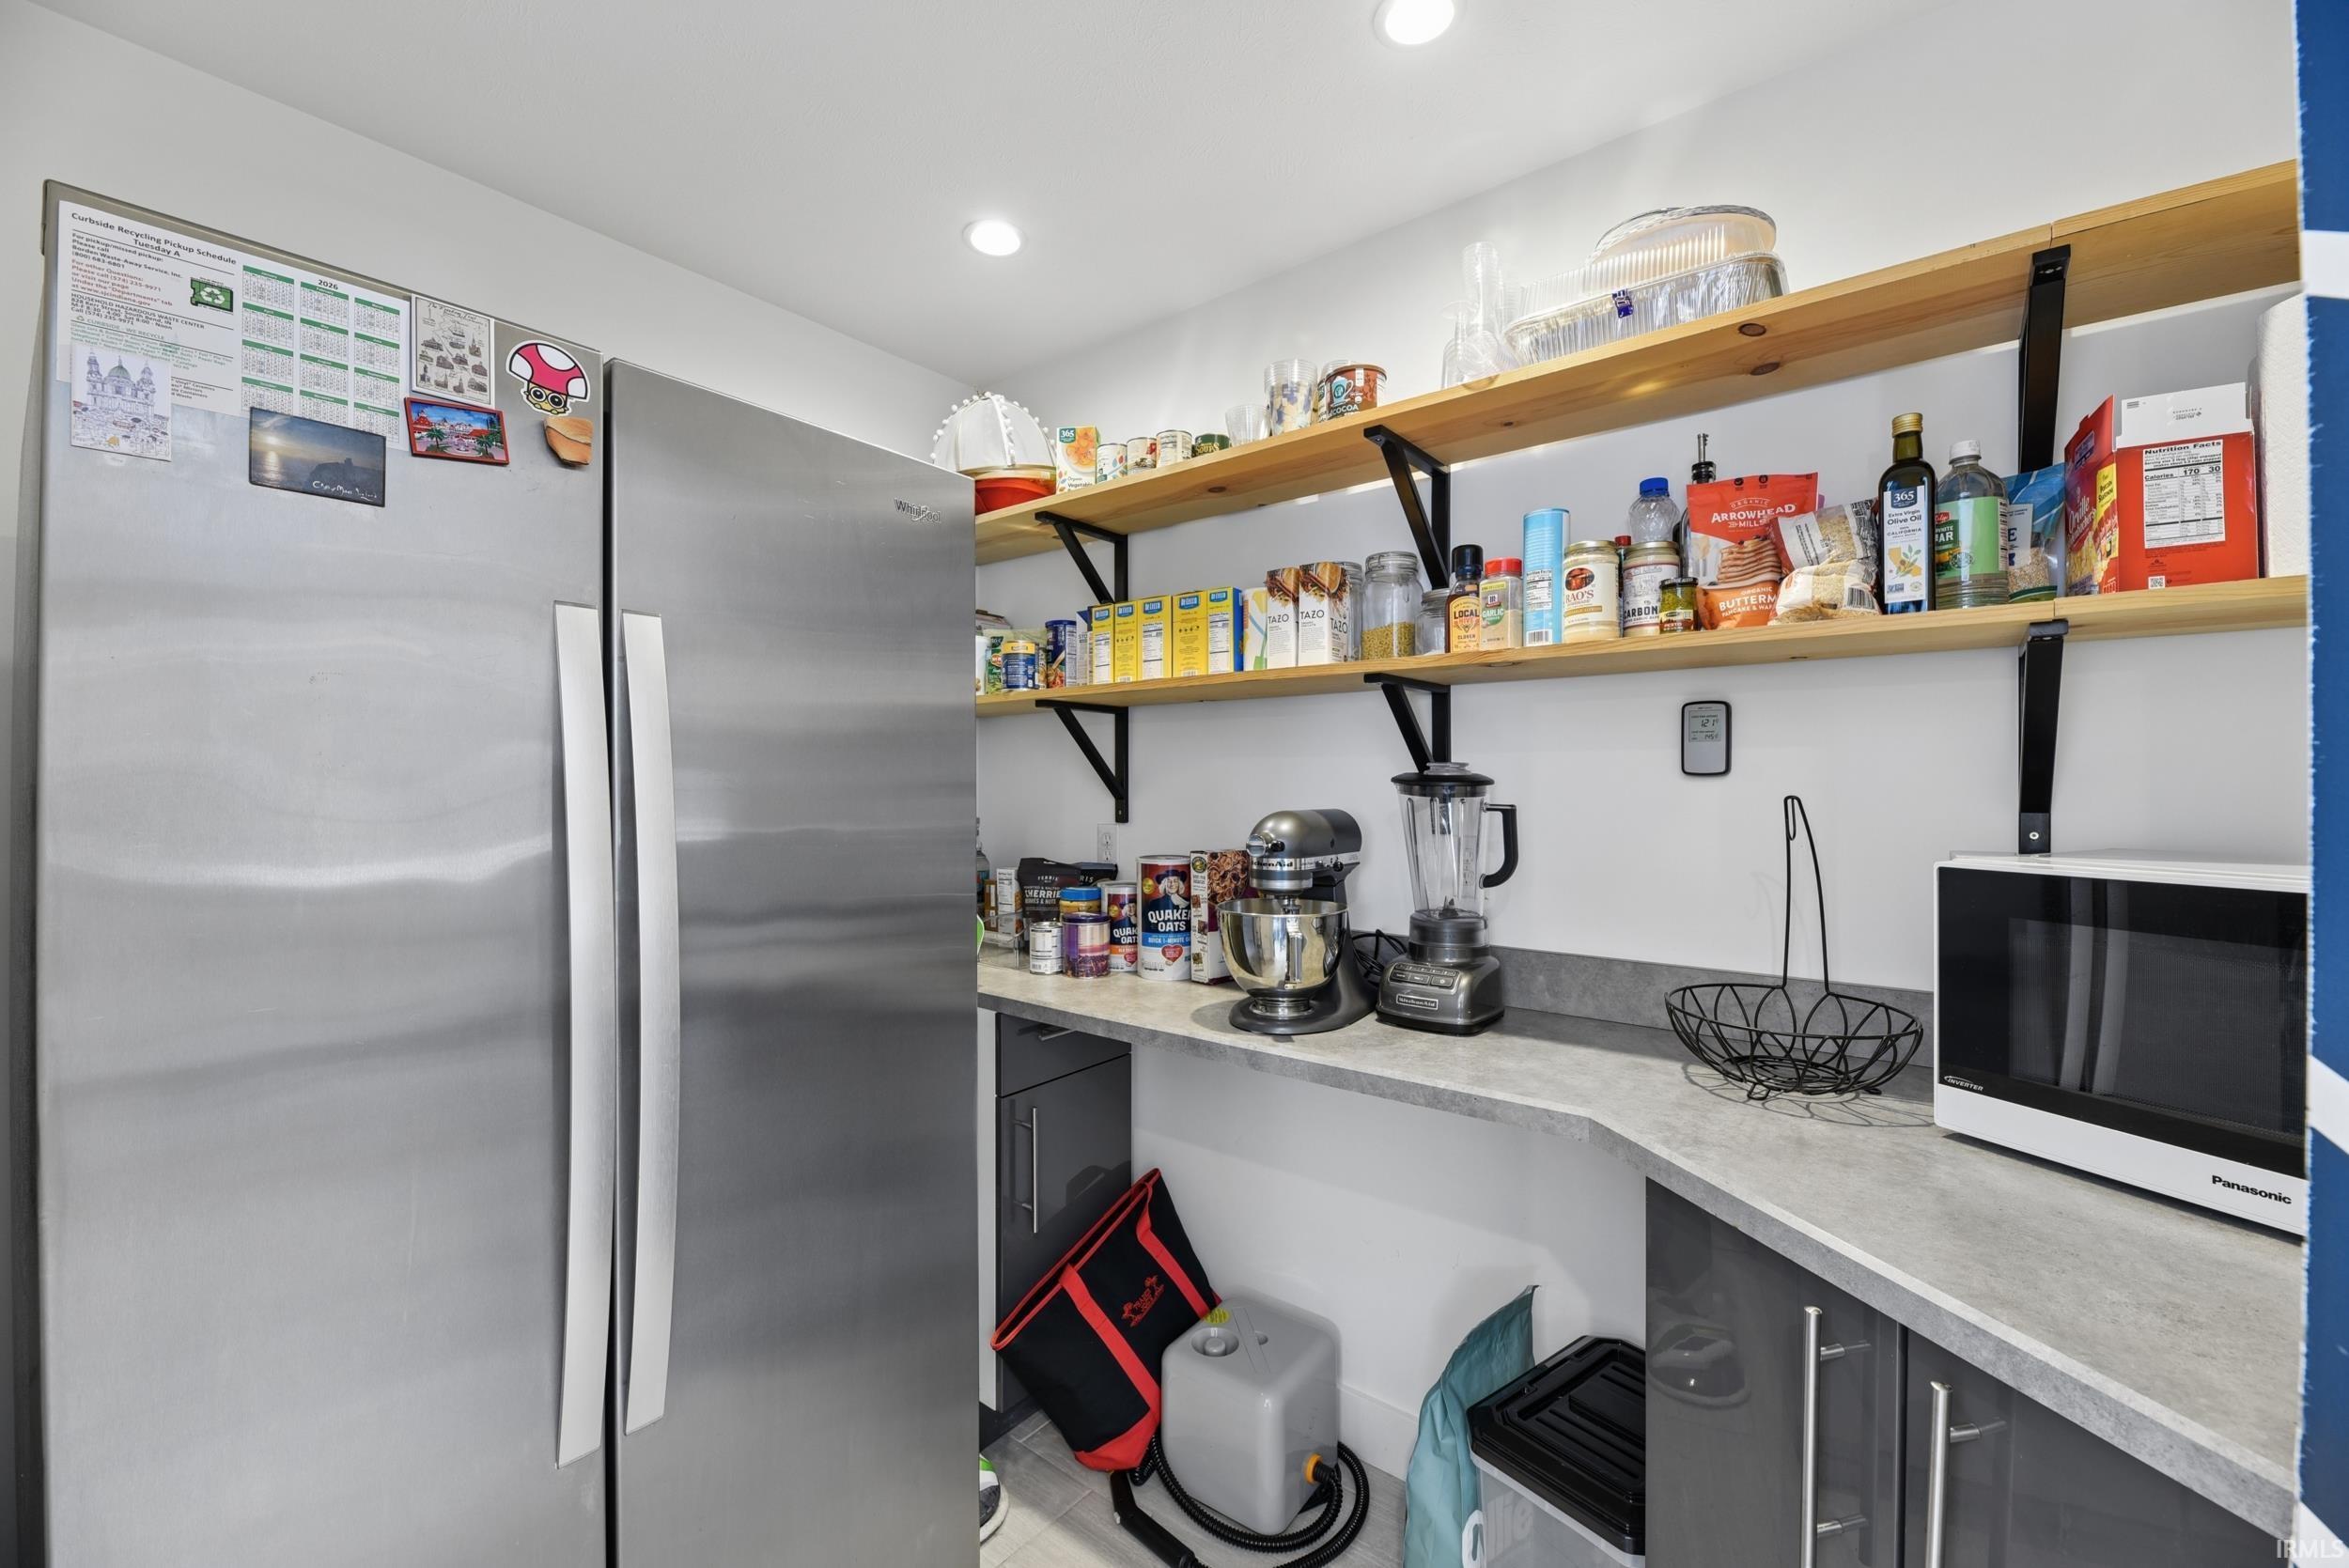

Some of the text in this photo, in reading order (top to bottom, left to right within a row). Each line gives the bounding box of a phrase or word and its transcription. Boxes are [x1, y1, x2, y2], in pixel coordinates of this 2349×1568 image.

[71, 212, 237, 264] Curbside Recycling Pickup Schedule
[72, 239, 95, 249] Please
[133, 239, 171, 256] Tuesday
[318, 279, 338, 290] 2026
[71, 293, 205, 329] HOUSEHOLD HAZARDOUS WASTE CENTER
[1060, 429, 1075, 439] 365
[2145, 446, 2189, 455] Nutrition
[1894, 491, 1915, 503] 365
[1731, 499, 1769, 508] ORGANIC
[894, 498, 941, 522] Whirlpool
[1711, 504, 1797, 523] ARROWHEAD
[2069, 496, 2090, 535] Orville
[1738, 519, 1766, 527] MILLS
[1887, 528, 1921, 536] CALIFORNIA
[1565, 589, 1595, 602] RAO'S
[1741, 586, 1773, 596] ORGANIC
[1719, 594, 1777, 612] BUTTERM
[1300, 609, 1325, 620] TAZO
[1454, 609, 1480, 620] LOCAL
[1482, 609, 1504, 618] GARLIC
[1624, 605, 1658, 620] CARBON
[1721, 606, 1750, 617] PANCAKE
[1268, 613, 1290, 624] TAZO
[1330, 617, 1348, 634] TAZO
[1024, 890, 1062, 899] CHERRIE
[1113, 926, 1138, 939] QUAK
[1158, 922, 1187, 932] OATS
[1121, 936, 1138, 944] OAT
[1947, 1078, 1983, 1091] INVERTER
[2212, 1174, 2292, 1204] Panasonic
